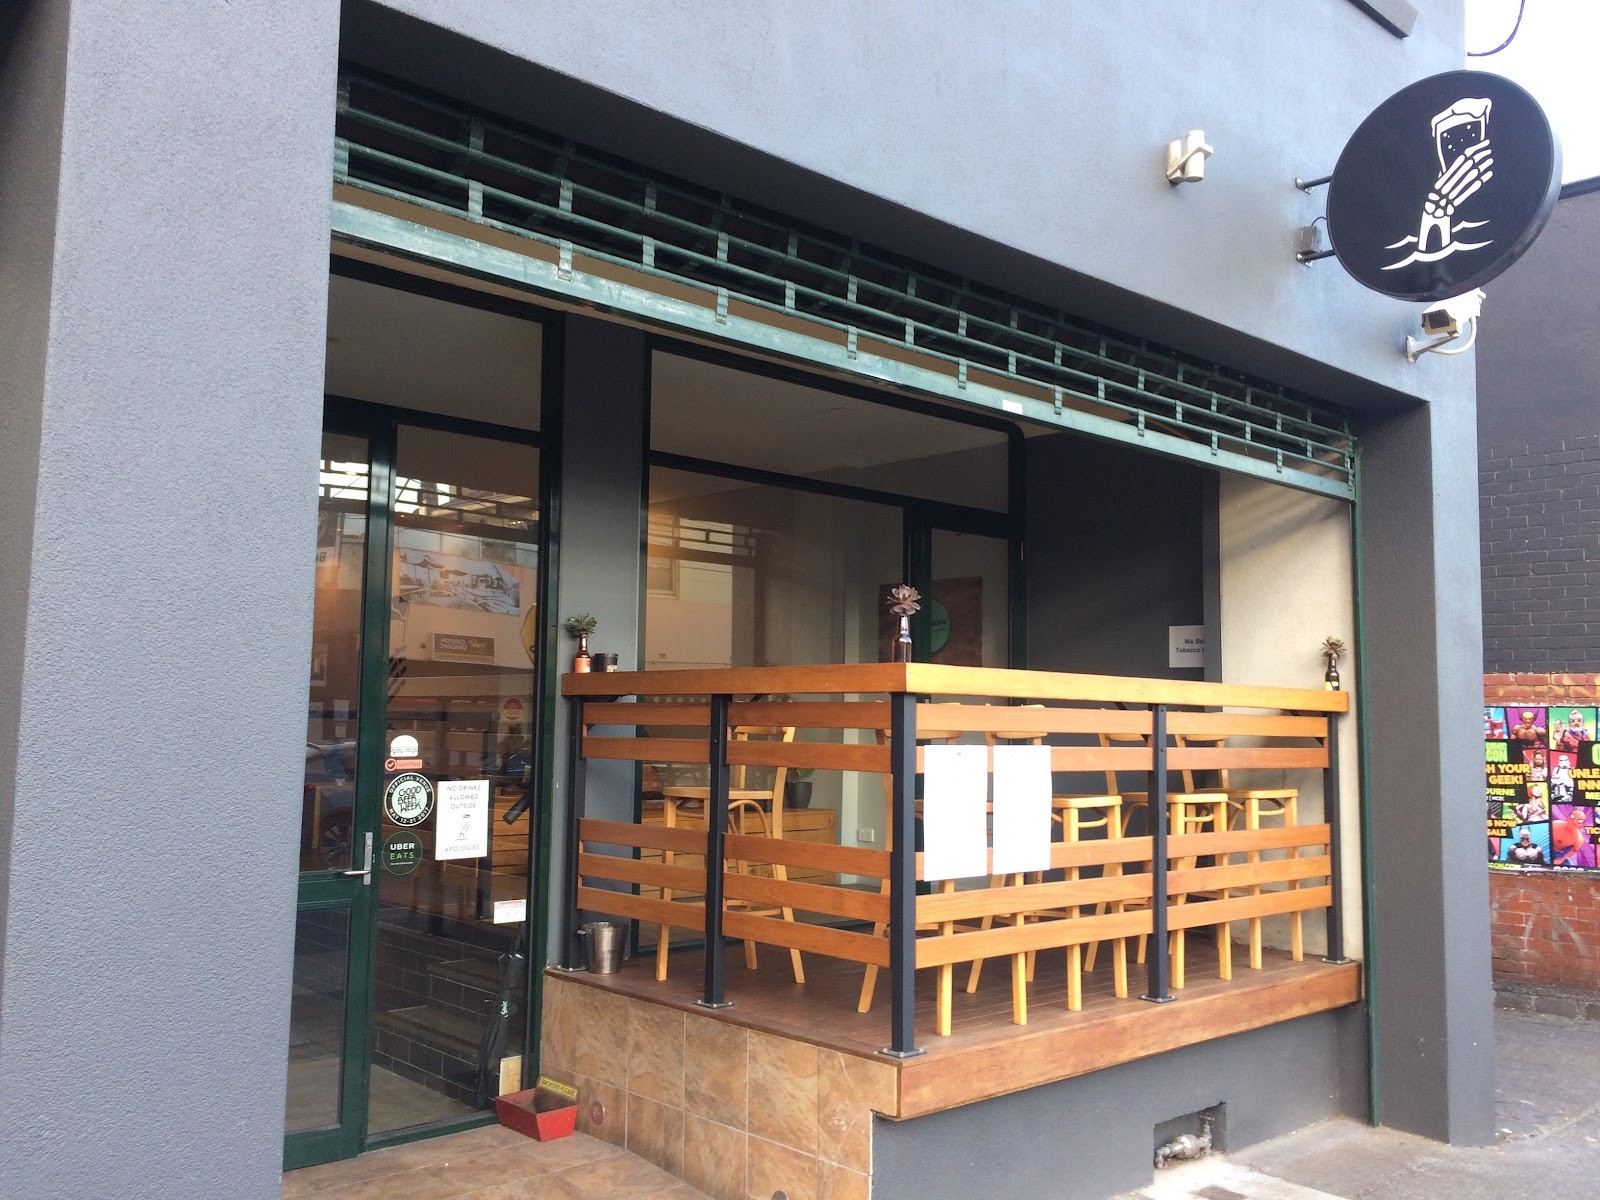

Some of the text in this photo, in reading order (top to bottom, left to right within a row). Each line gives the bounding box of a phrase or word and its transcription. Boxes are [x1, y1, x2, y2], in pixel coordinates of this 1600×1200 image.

[1497, 763, 1531, 774] YOUR
[389, 775, 431, 793] OFFICIAL VENUE
[1488, 774, 1524, 785] GEEK!
[398, 786, 422, 797] GOOD
[397, 794, 417, 805] BEER
[400, 801, 422, 813] WEEK
[388, 808, 400, 820] MAY
[417, 806, 430, 819] 2017
[1494, 819, 1518, 828] NOW
[390, 842, 416, 851] UBER
[444, 844, 479, 852] APOLOGIES
[390, 851, 415, 860] EATS
